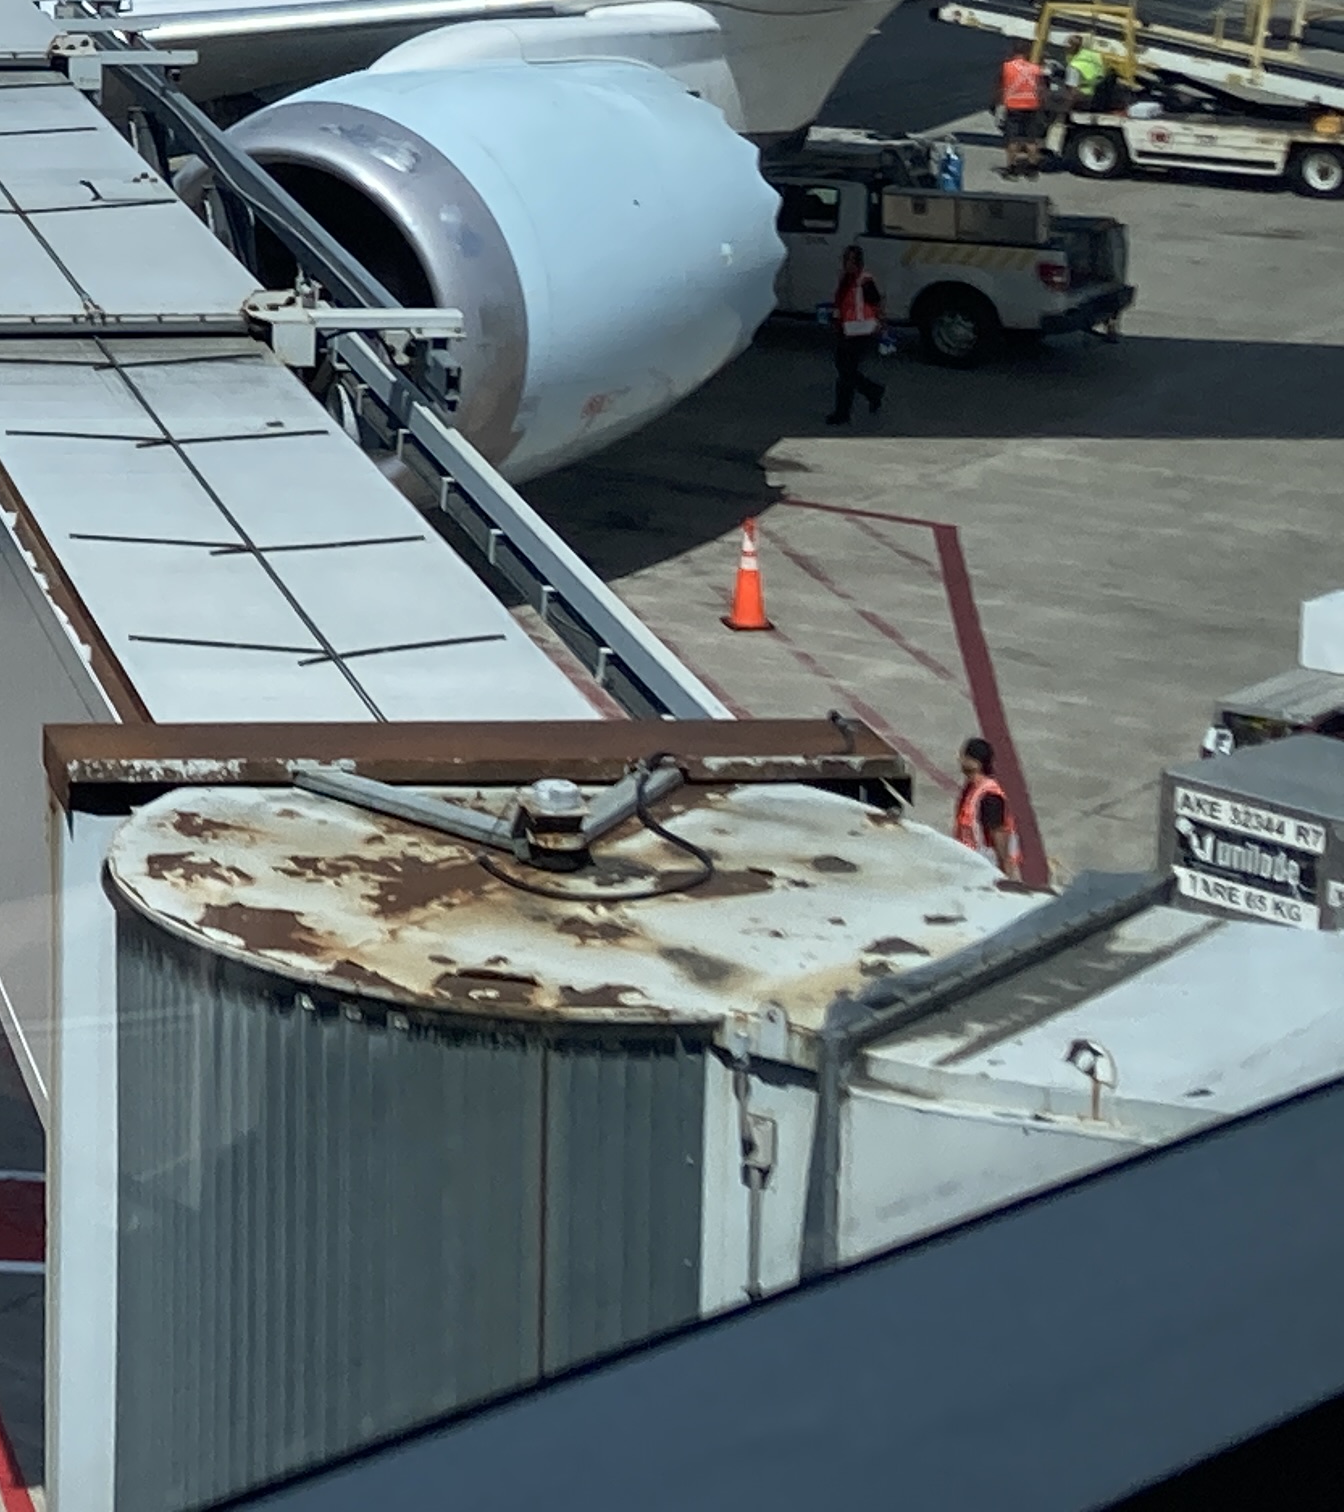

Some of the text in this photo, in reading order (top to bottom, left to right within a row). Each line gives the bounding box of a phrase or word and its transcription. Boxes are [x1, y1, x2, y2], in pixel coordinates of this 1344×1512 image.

[1180, 793, 1223, 821] AKE
[1188, 872, 1242, 906] TARE
[1272, 898, 1302, 922] KG
